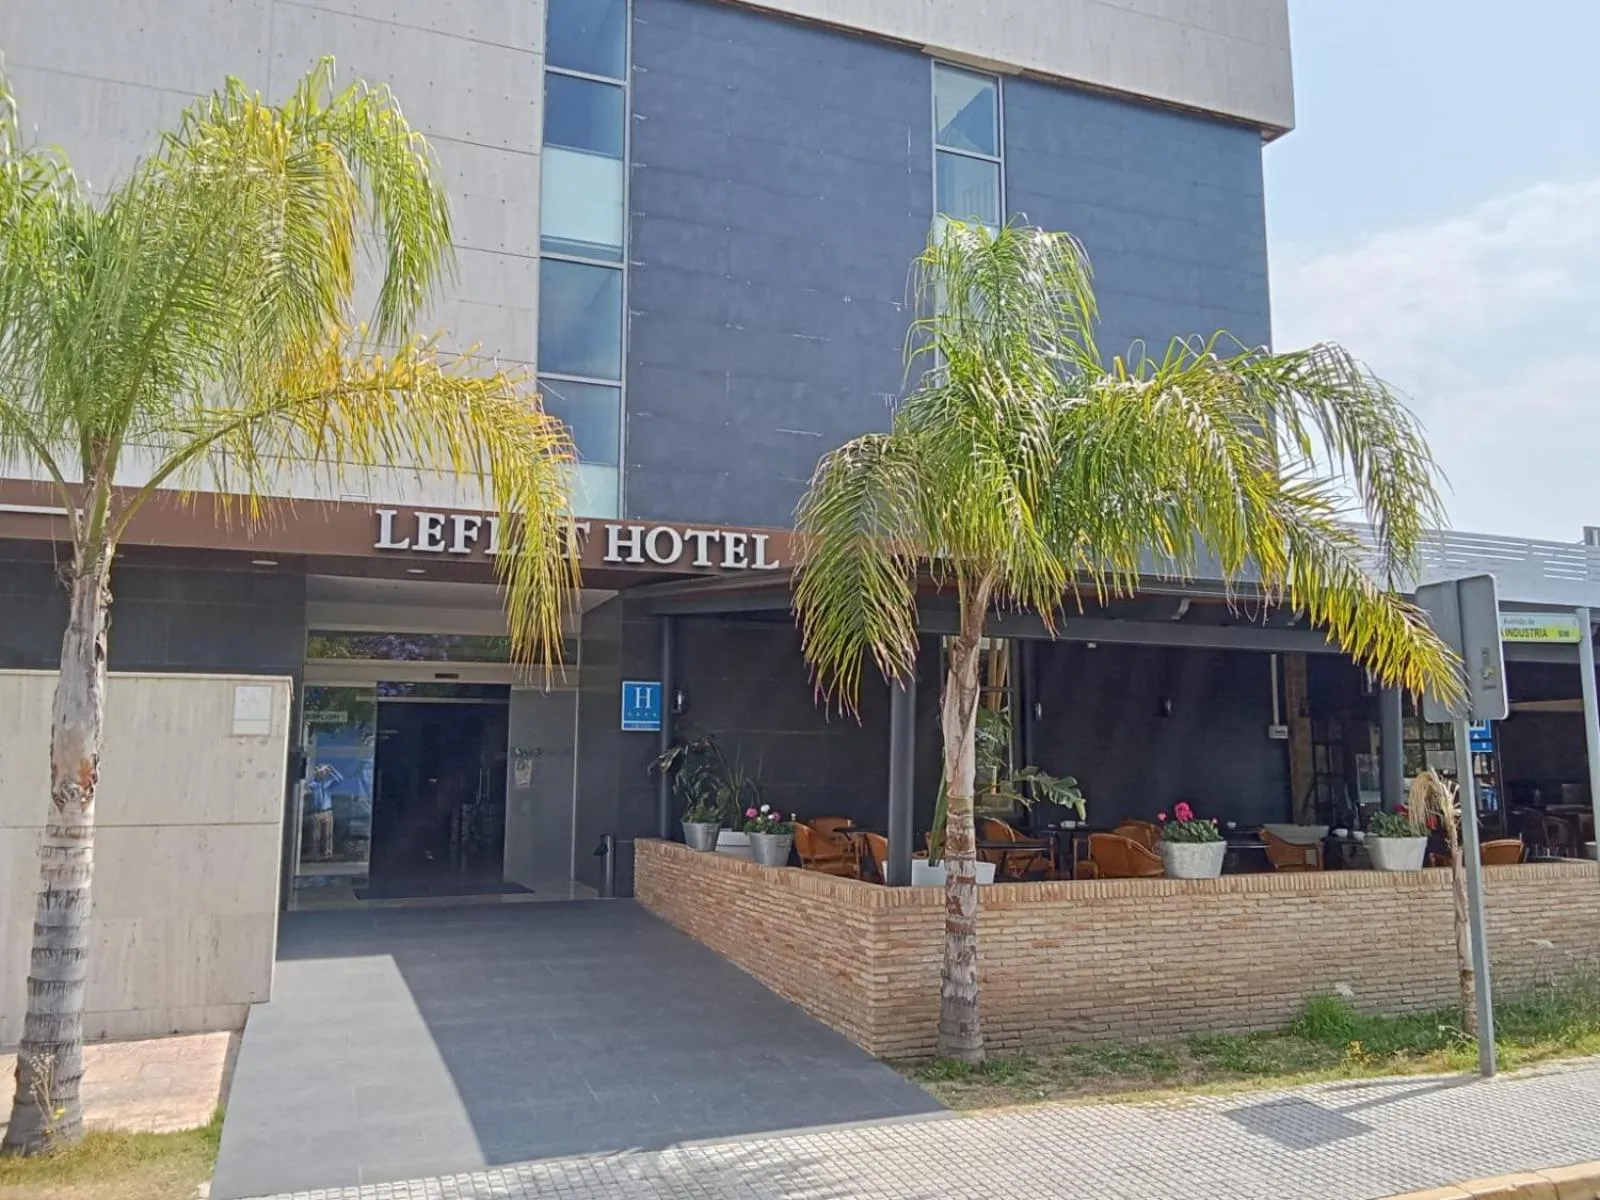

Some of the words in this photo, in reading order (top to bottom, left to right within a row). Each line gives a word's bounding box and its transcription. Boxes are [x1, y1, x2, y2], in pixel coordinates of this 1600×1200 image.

[374, 509, 590, 560] LEFLT
[603, 523, 780, 570] HOTEL
[1505, 627, 1549, 638] INDUSTRIA
[634, 687, 654, 709] H
